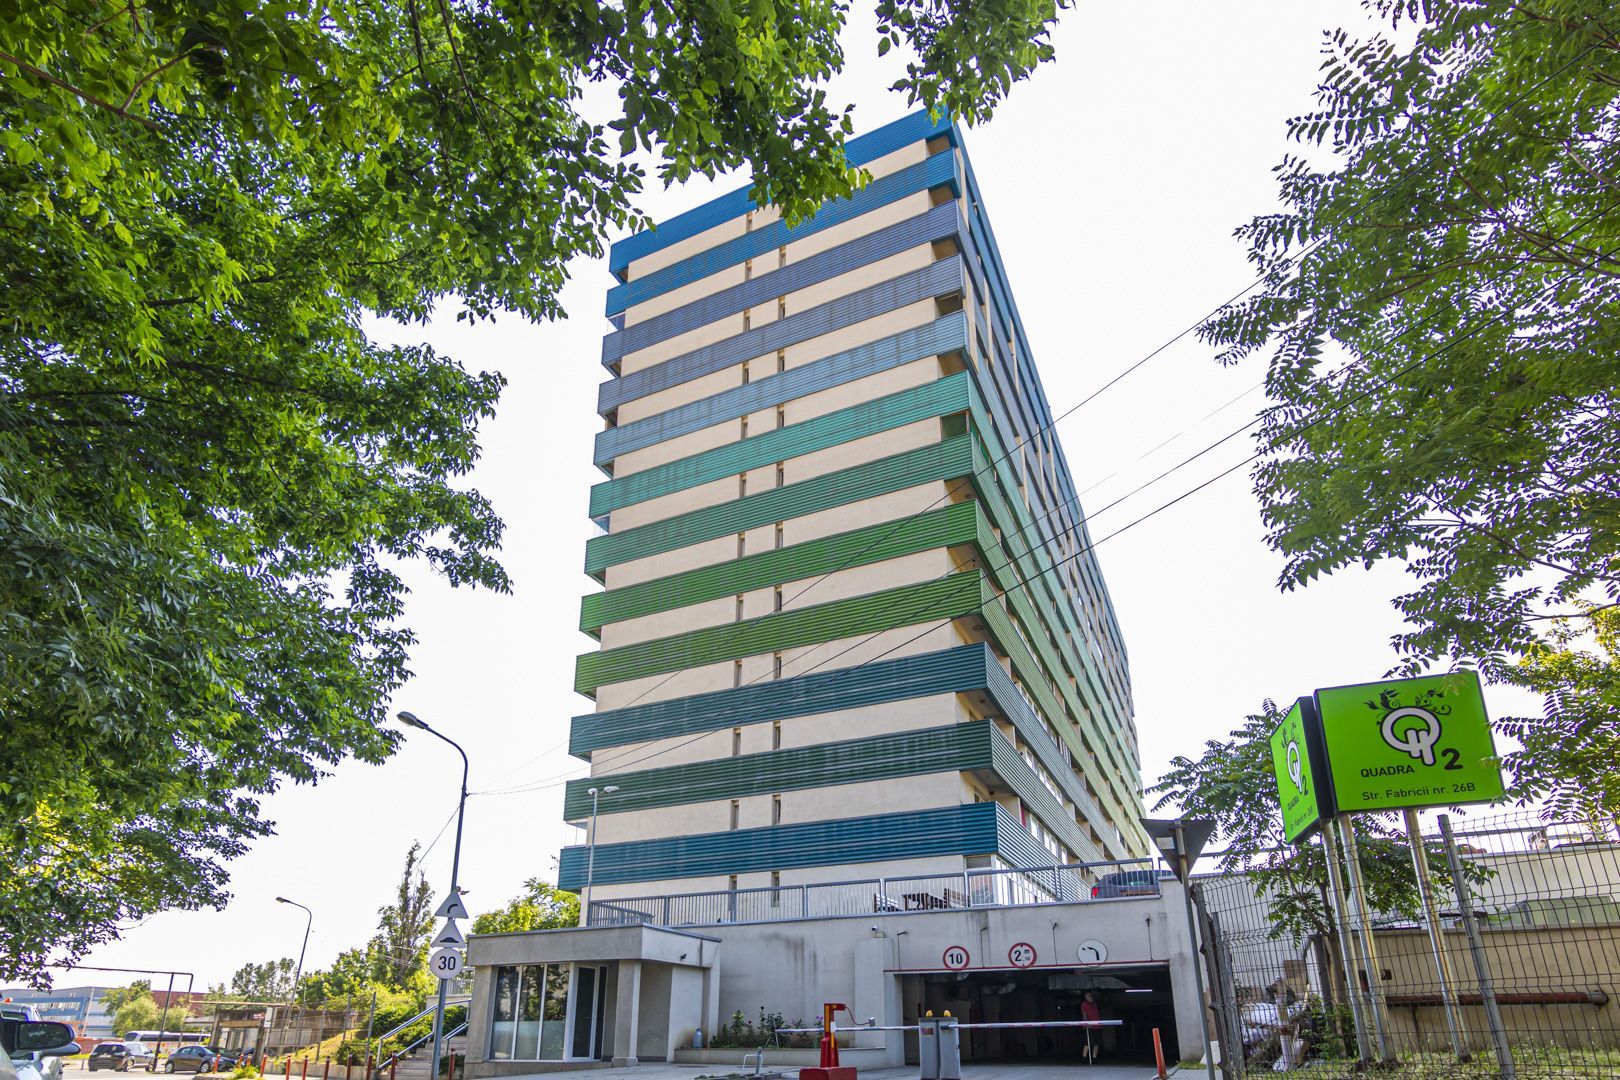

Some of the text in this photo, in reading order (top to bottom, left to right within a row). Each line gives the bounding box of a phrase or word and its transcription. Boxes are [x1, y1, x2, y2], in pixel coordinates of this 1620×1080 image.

[1441, 748, 1463, 770] 2
[1360, 764, 1415, 778] QUADRA
[1362, 783, 1476, 800] Str. Fabricii nr. 26B
[438, 955, 456, 970] 30
[948, 953, 963, 965] 10
